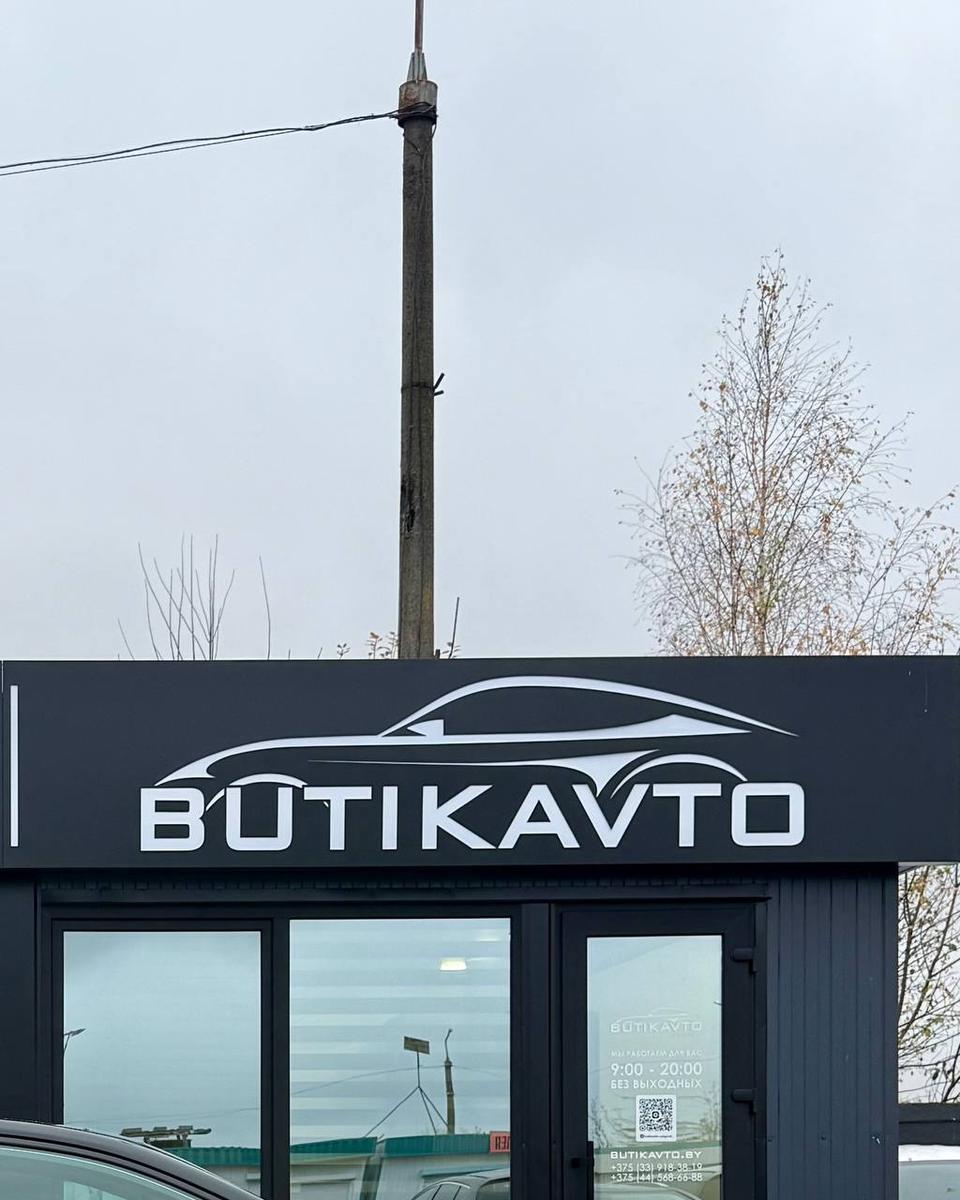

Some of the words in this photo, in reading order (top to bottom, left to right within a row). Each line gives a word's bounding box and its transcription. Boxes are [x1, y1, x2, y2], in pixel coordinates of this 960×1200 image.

[140, 782, 806, 852] BUTIKAVTO
[610, 1021, 702, 1033] BUTIKAVTO
[611, 1063, 643, 1076] 9:00
[659, 1062, 703, 1076] 20:00
[610, 1079, 630, 1089] БЕЗ
[633, 1079, 703, 1090] ВЫХОДНЫХ
[610, 1151, 702, 1159] BUTIKAVTO.BY
[611, 1163, 634, 1172] +375
[637, 1163, 654, 1174] (33)
[611, 1173, 634, 1182] +375
